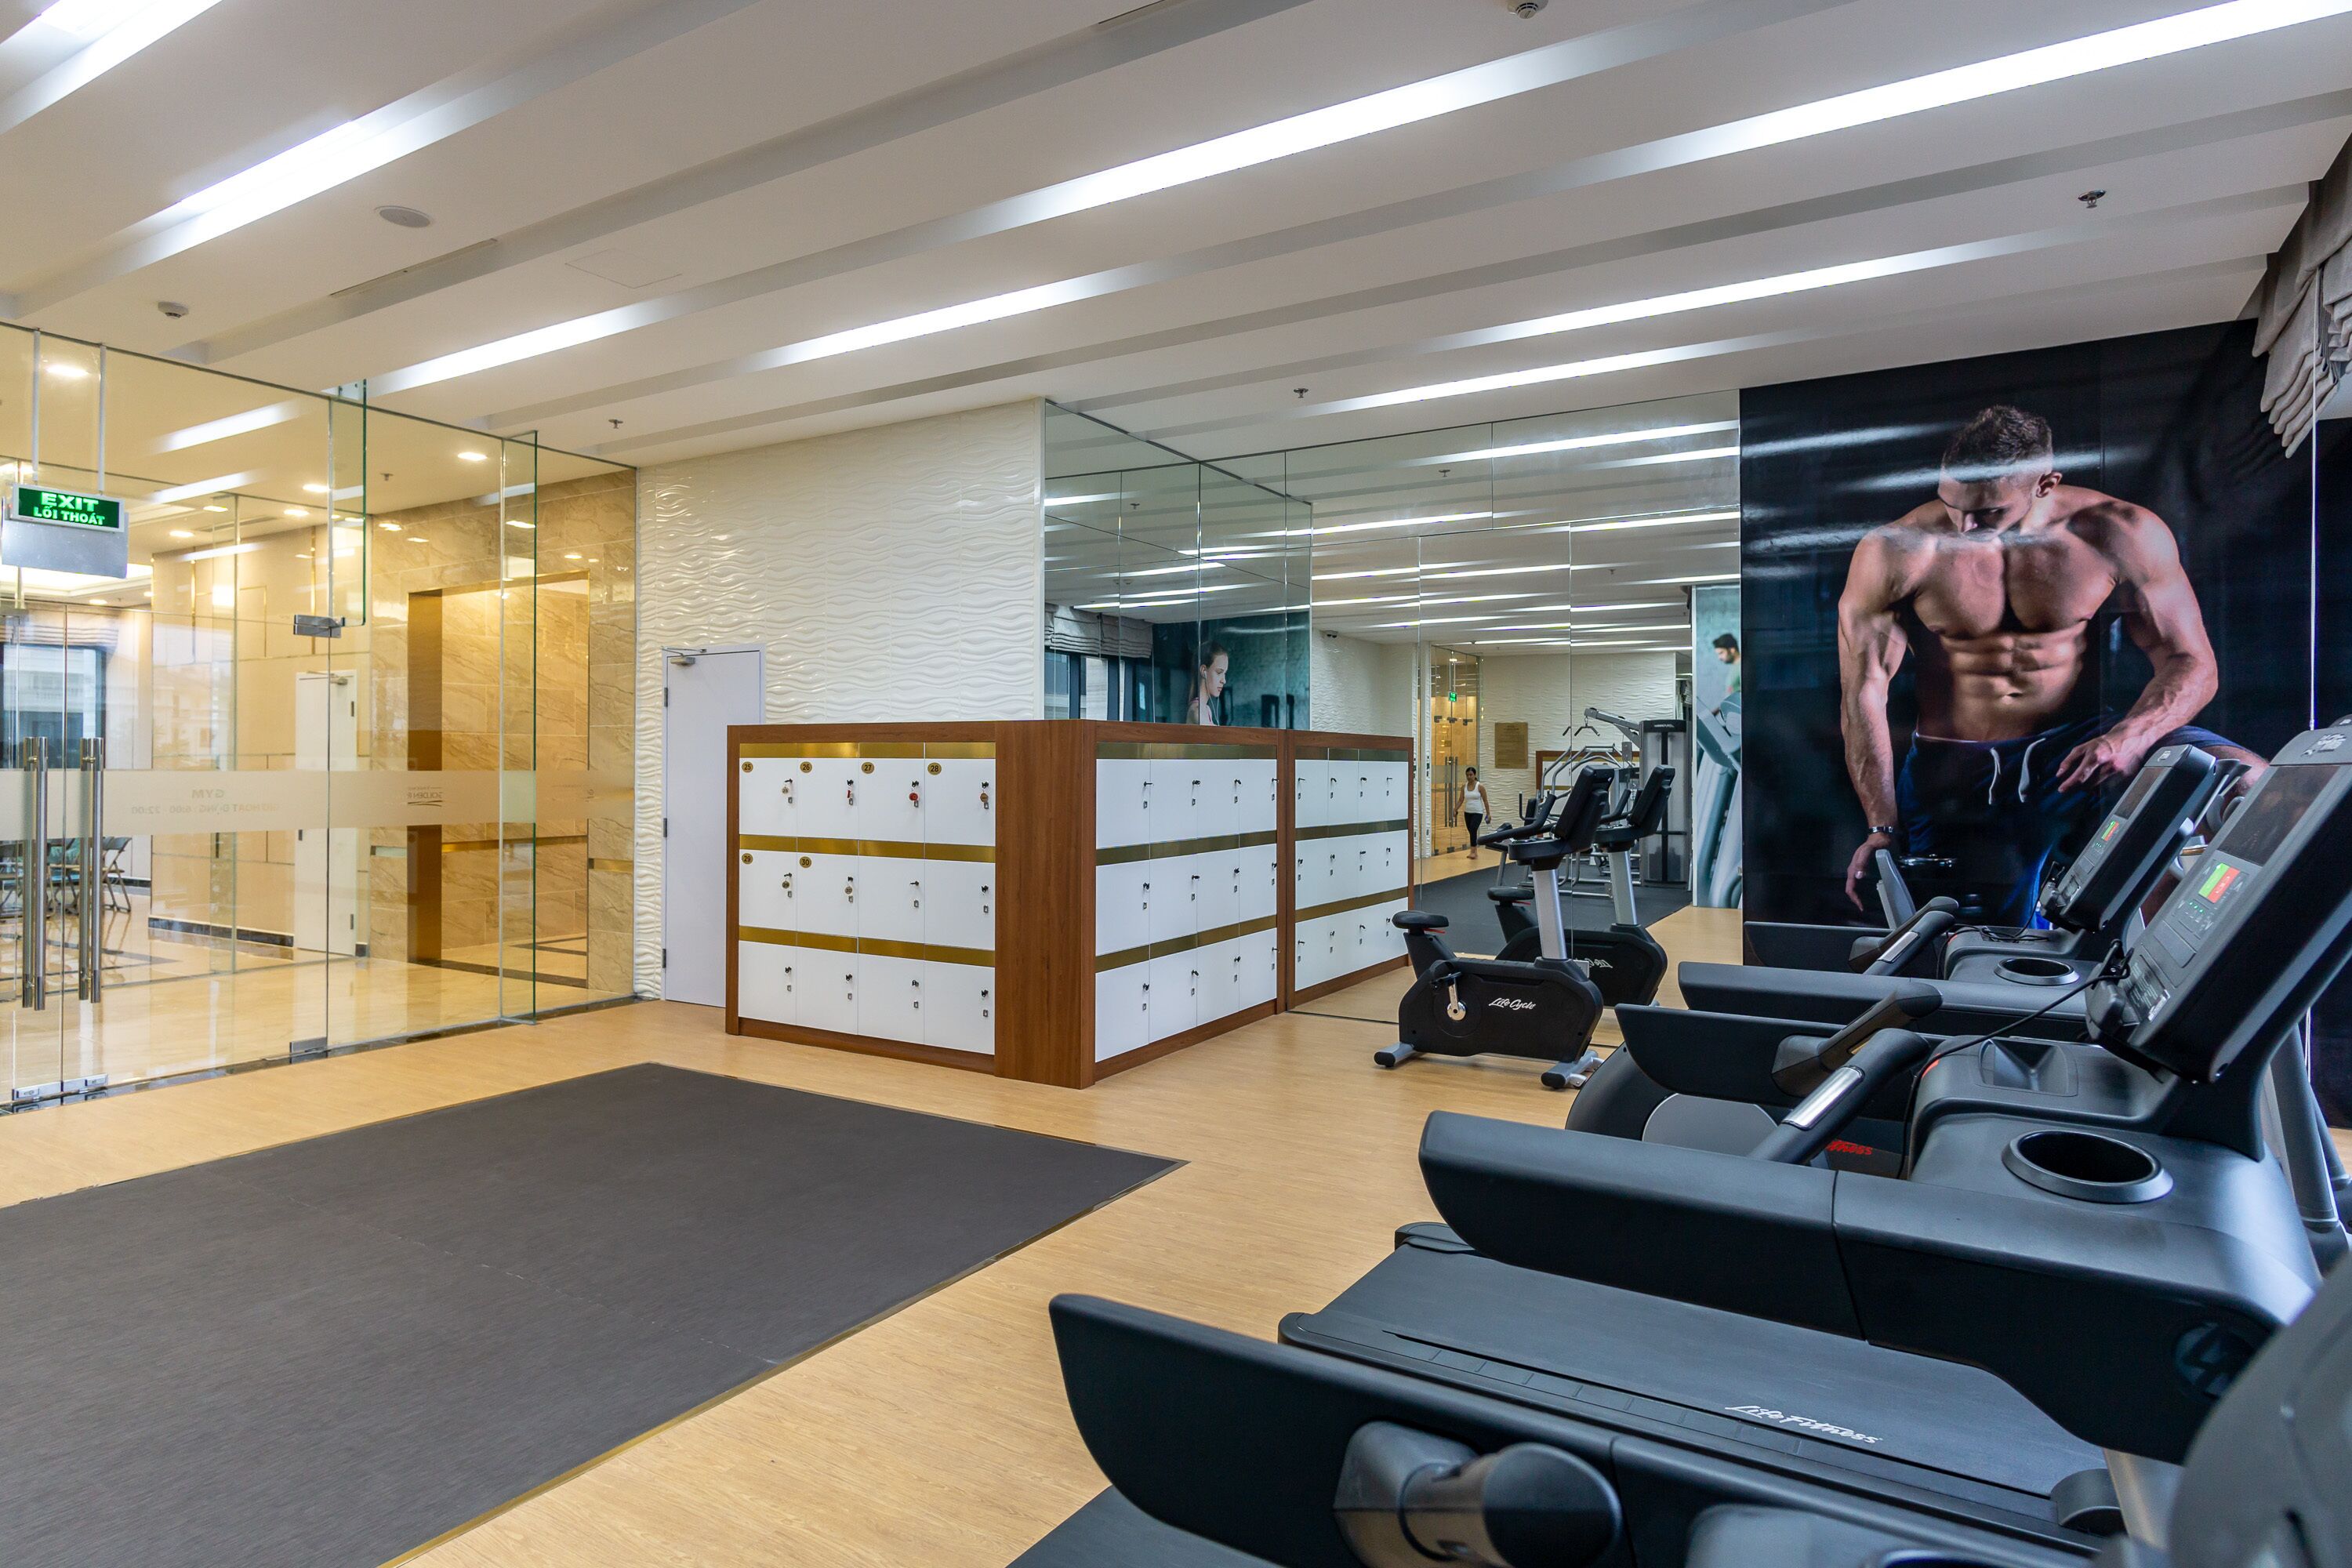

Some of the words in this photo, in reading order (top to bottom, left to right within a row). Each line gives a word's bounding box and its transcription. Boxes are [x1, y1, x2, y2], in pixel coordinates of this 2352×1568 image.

[41, 492, 99, 512] EXIT
[60, 512, 105, 526] THOÁT
[1725, 1405, 1784, 1419] Life
[1779, 1414, 1879, 1443] Fitness
